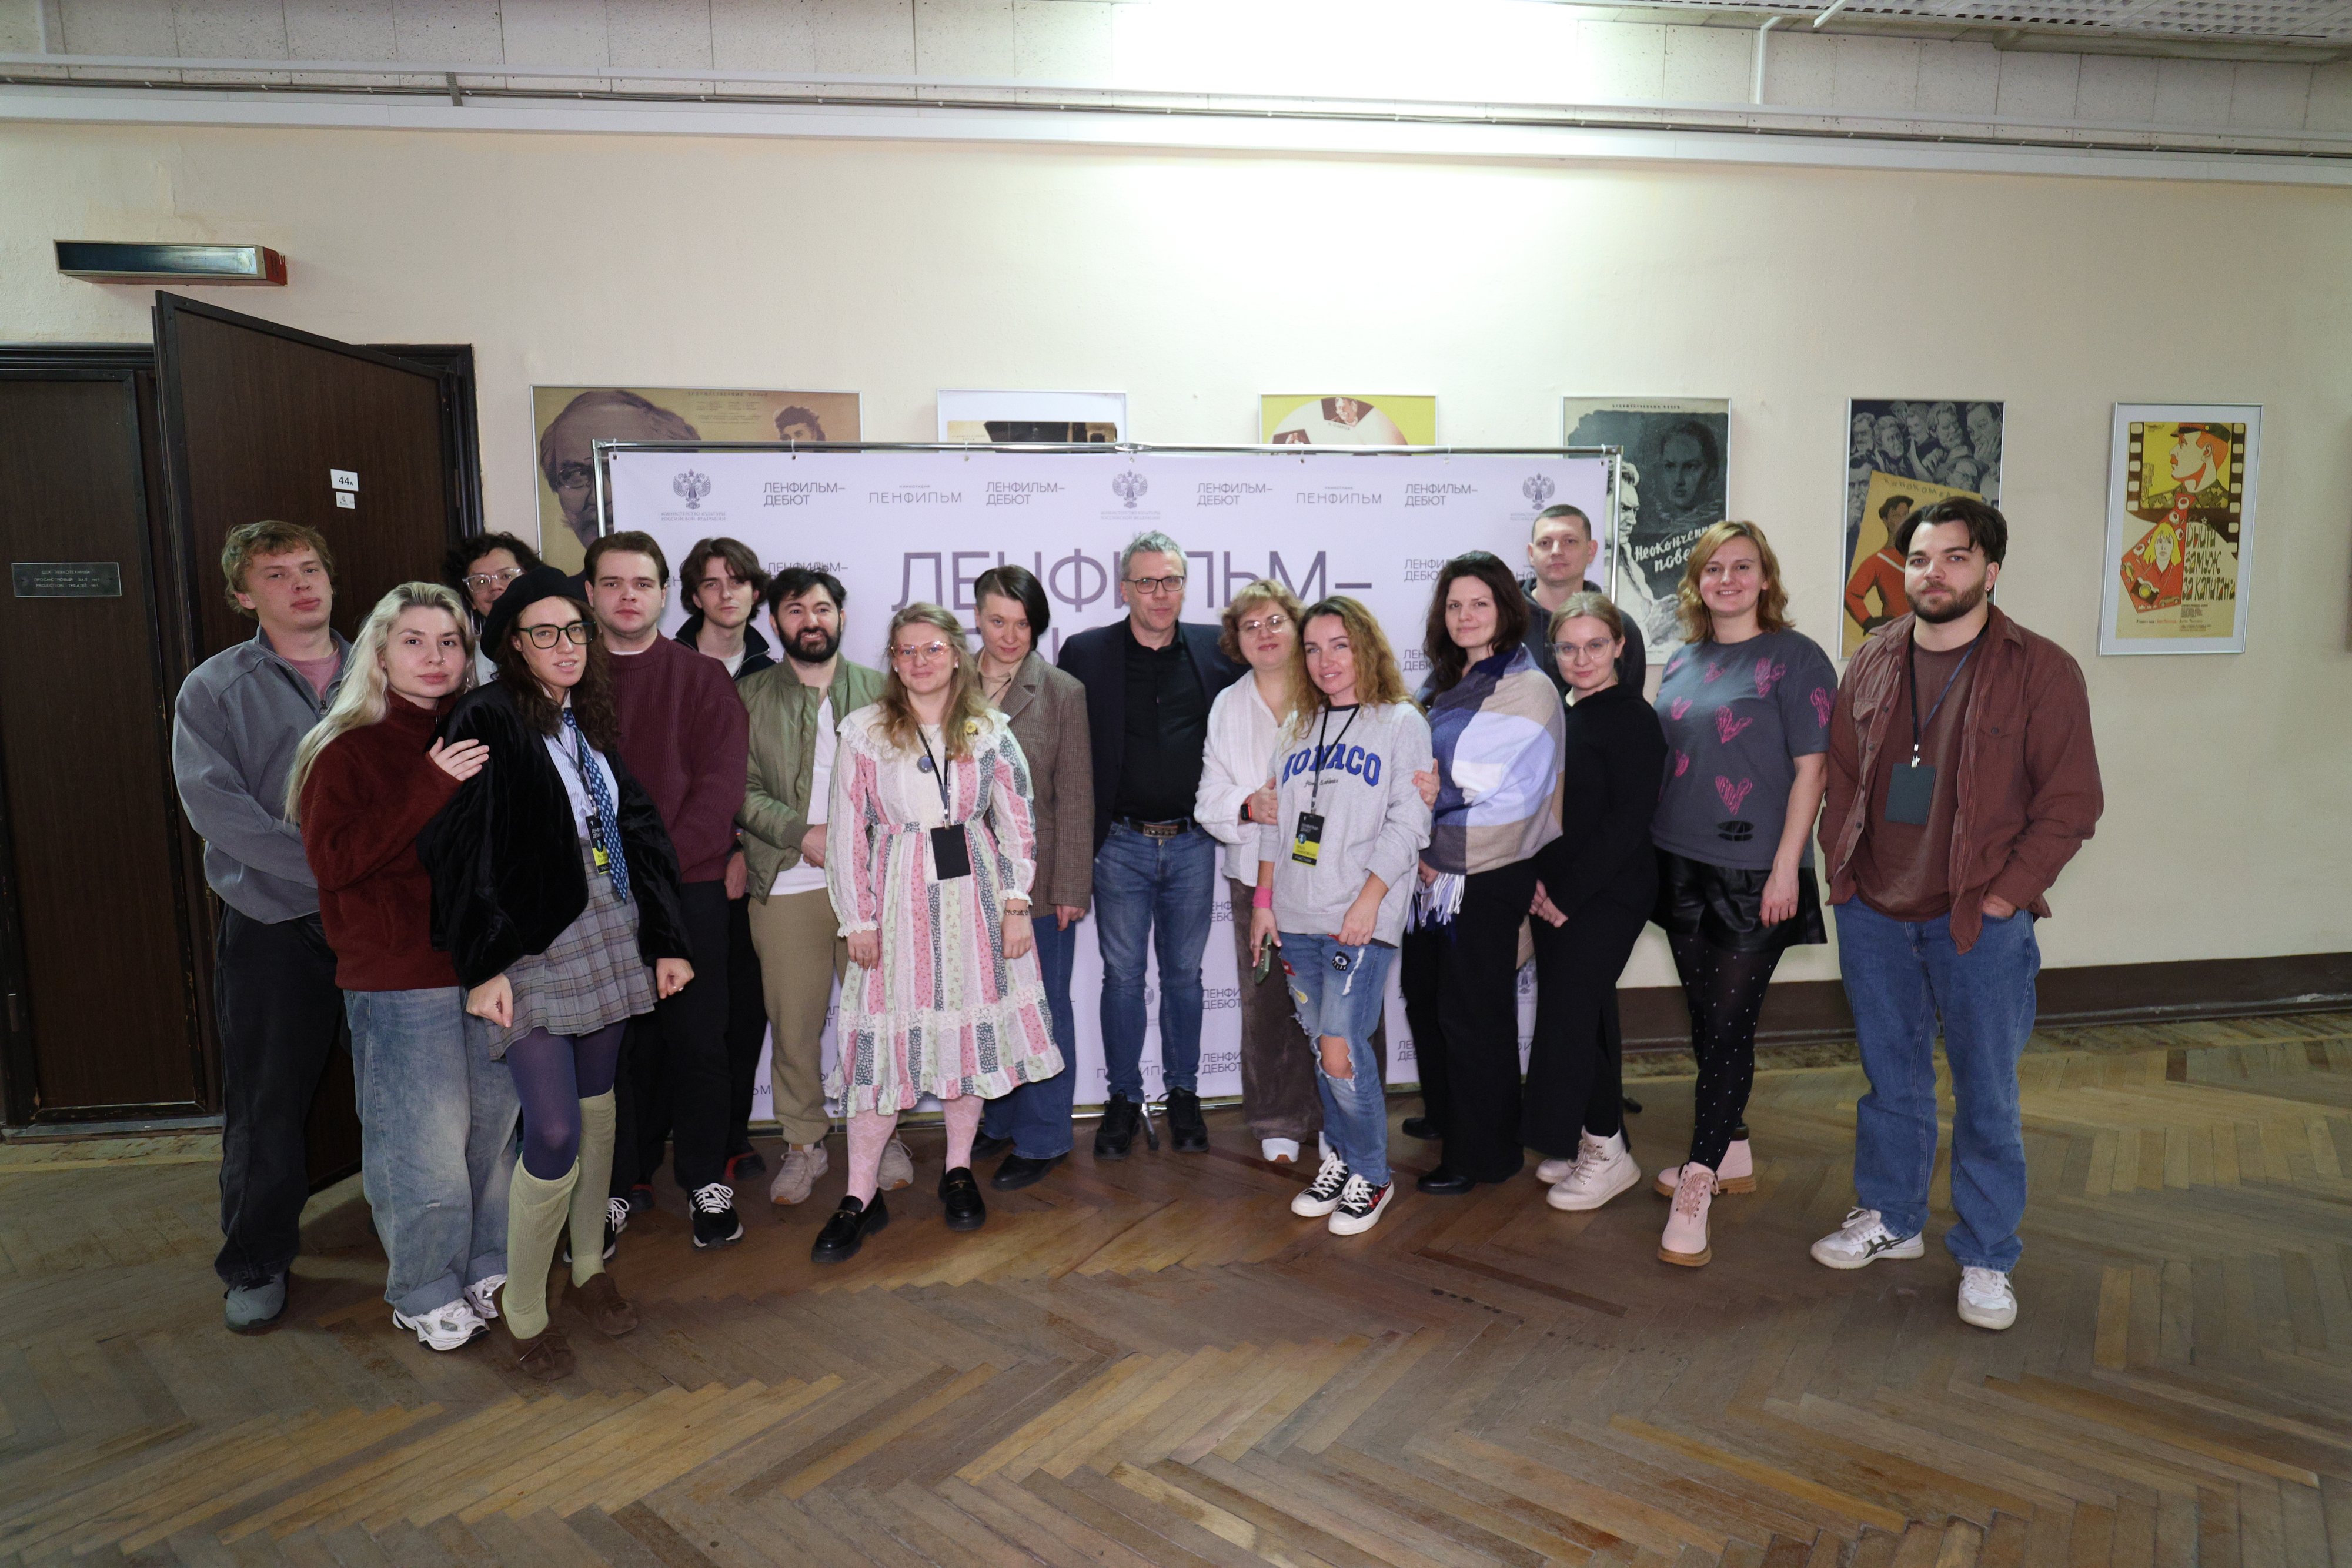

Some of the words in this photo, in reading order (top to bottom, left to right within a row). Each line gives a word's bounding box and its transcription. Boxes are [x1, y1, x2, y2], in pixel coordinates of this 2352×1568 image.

[764, 495, 810, 507] ДЕБЮТ
[869, 492, 962, 504] ЛЕНФИЛЬМ
[986, 494, 1031, 506] ДЕБЮТ
[1197, 495, 1240, 507] ДЕБЮТ
[1296, 493, 1382, 504] ЛЕНФИЛЬМ
[1405, 496, 1446, 507] ДЕБЮТ
[1405, 559, 1444, 569] ЛЕНФИ
[1654, 547, 1692, 573] пове
[1404, 571, 1439, 582] ДЕБЮ
